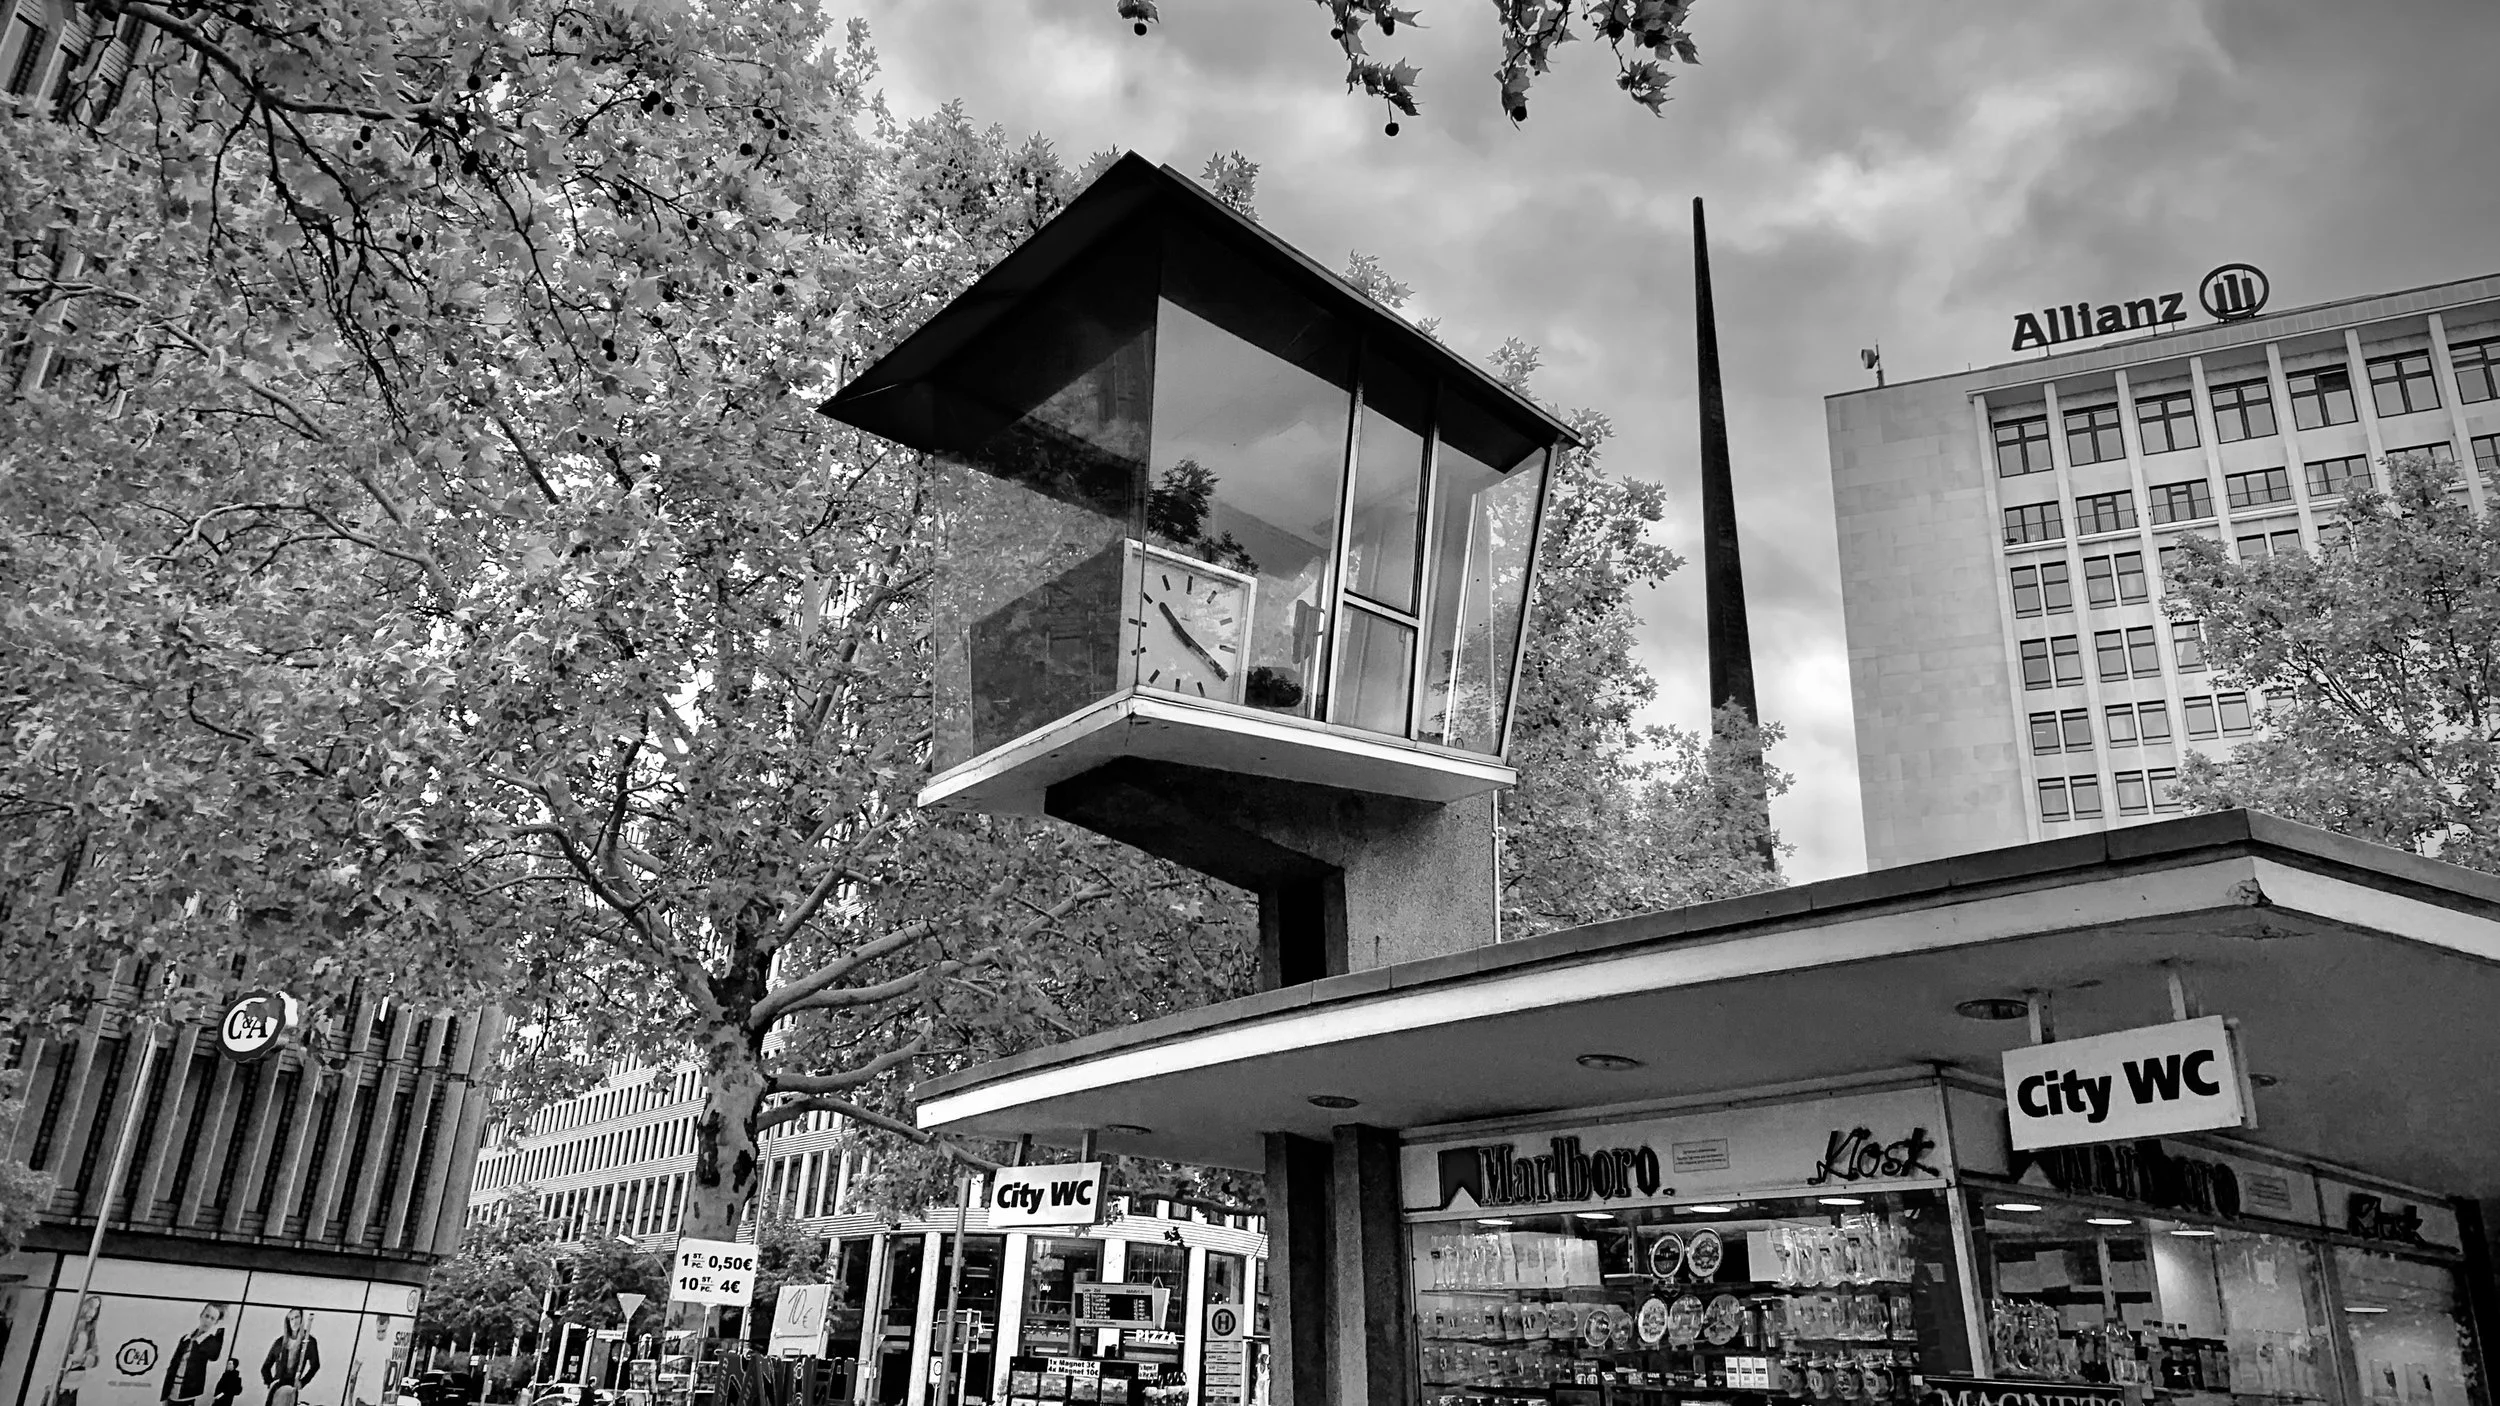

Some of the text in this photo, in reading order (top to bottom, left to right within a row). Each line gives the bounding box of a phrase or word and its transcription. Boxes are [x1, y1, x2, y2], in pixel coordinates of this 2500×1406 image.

[2011, 291, 2187, 351] Allianz
[228, 1009, 268, 1040] C&A
[2017, 1049, 2221, 1124] City WC
[1478, 1136, 1660, 1206] Marlboro
[997, 1180, 1094, 1215] City WC
[682, 1253, 689, 1266] 1
[708, 1255, 753, 1271] 0,50€
[680, 1277, 698, 1291] 10
[720, 1280, 741, 1294] 4€
[1135, 1329, 1178, 1346] PIZZA
[123, 1348, 149, 1366] C&A
[1059, 1359, 1085, 1368] Magnet
[1058, 1366, 1085, 1375] Magnet
